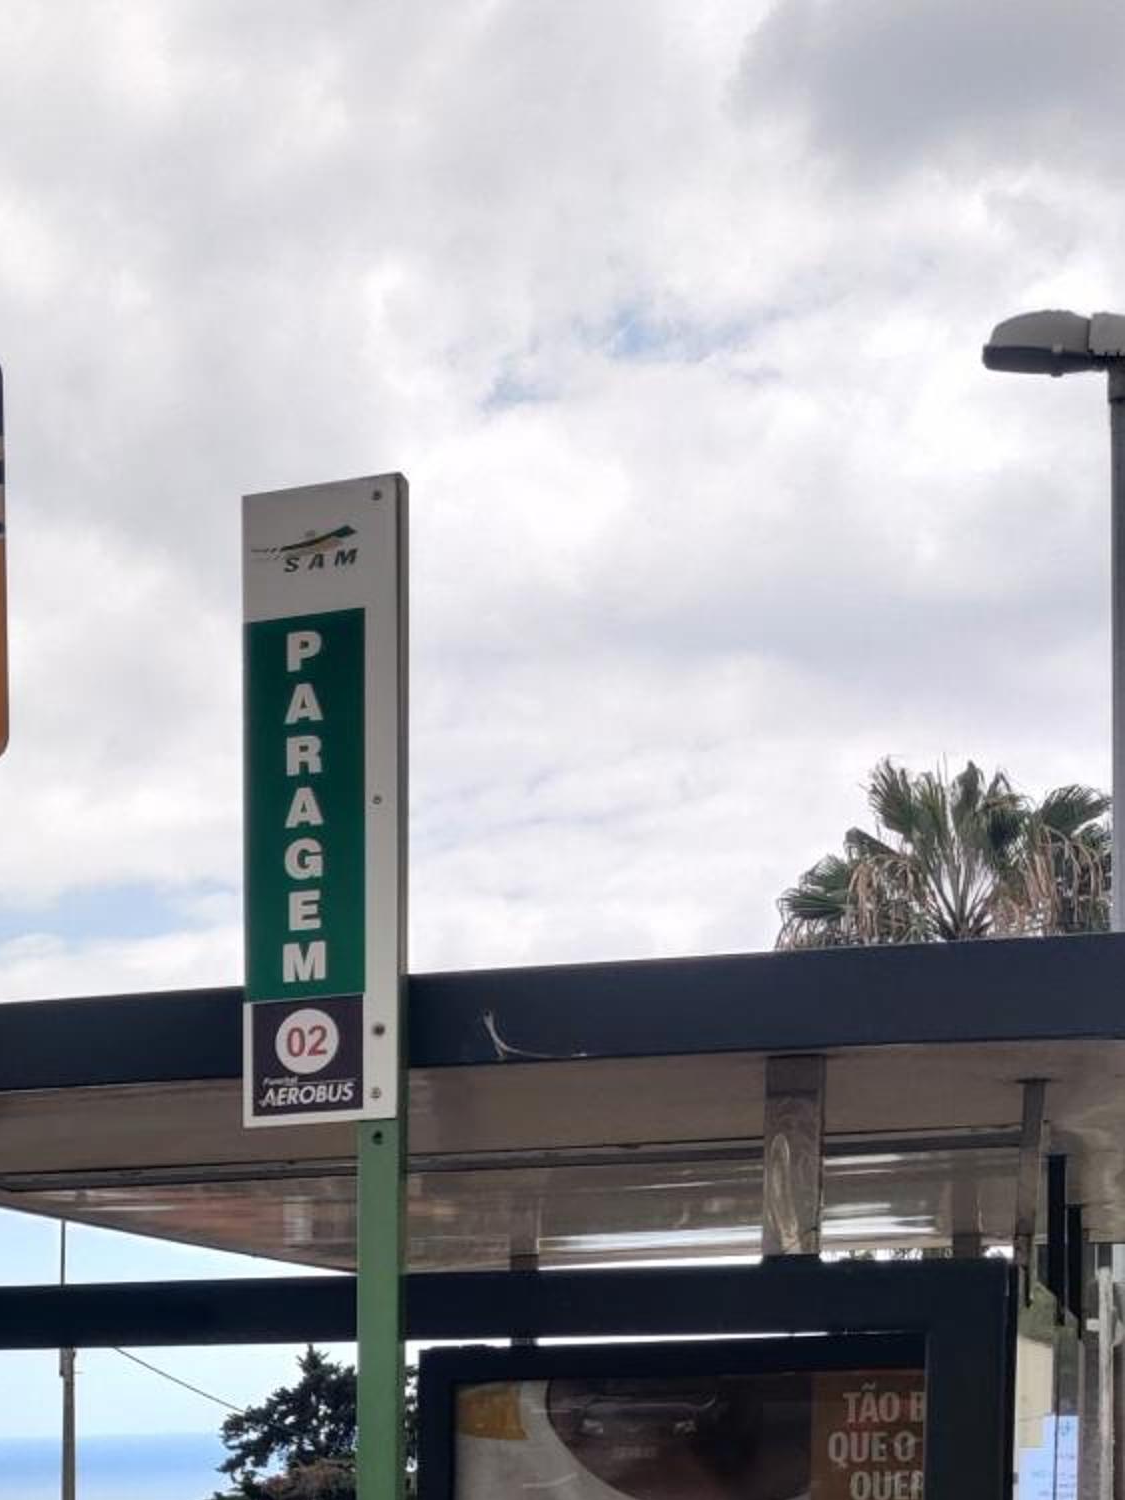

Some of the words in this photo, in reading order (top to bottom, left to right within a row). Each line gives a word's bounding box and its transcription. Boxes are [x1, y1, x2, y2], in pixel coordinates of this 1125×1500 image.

[284, 548, 358, 573] SAM
[283, 630, 328, 983] PARAGEM
[286, 1025, 328, 1058] 02
[259, 1081, 356, 1107] AEROBUS
[842, 1382, 900, 1423] TÃO
[828, 1431, 887, 1470] QUE
